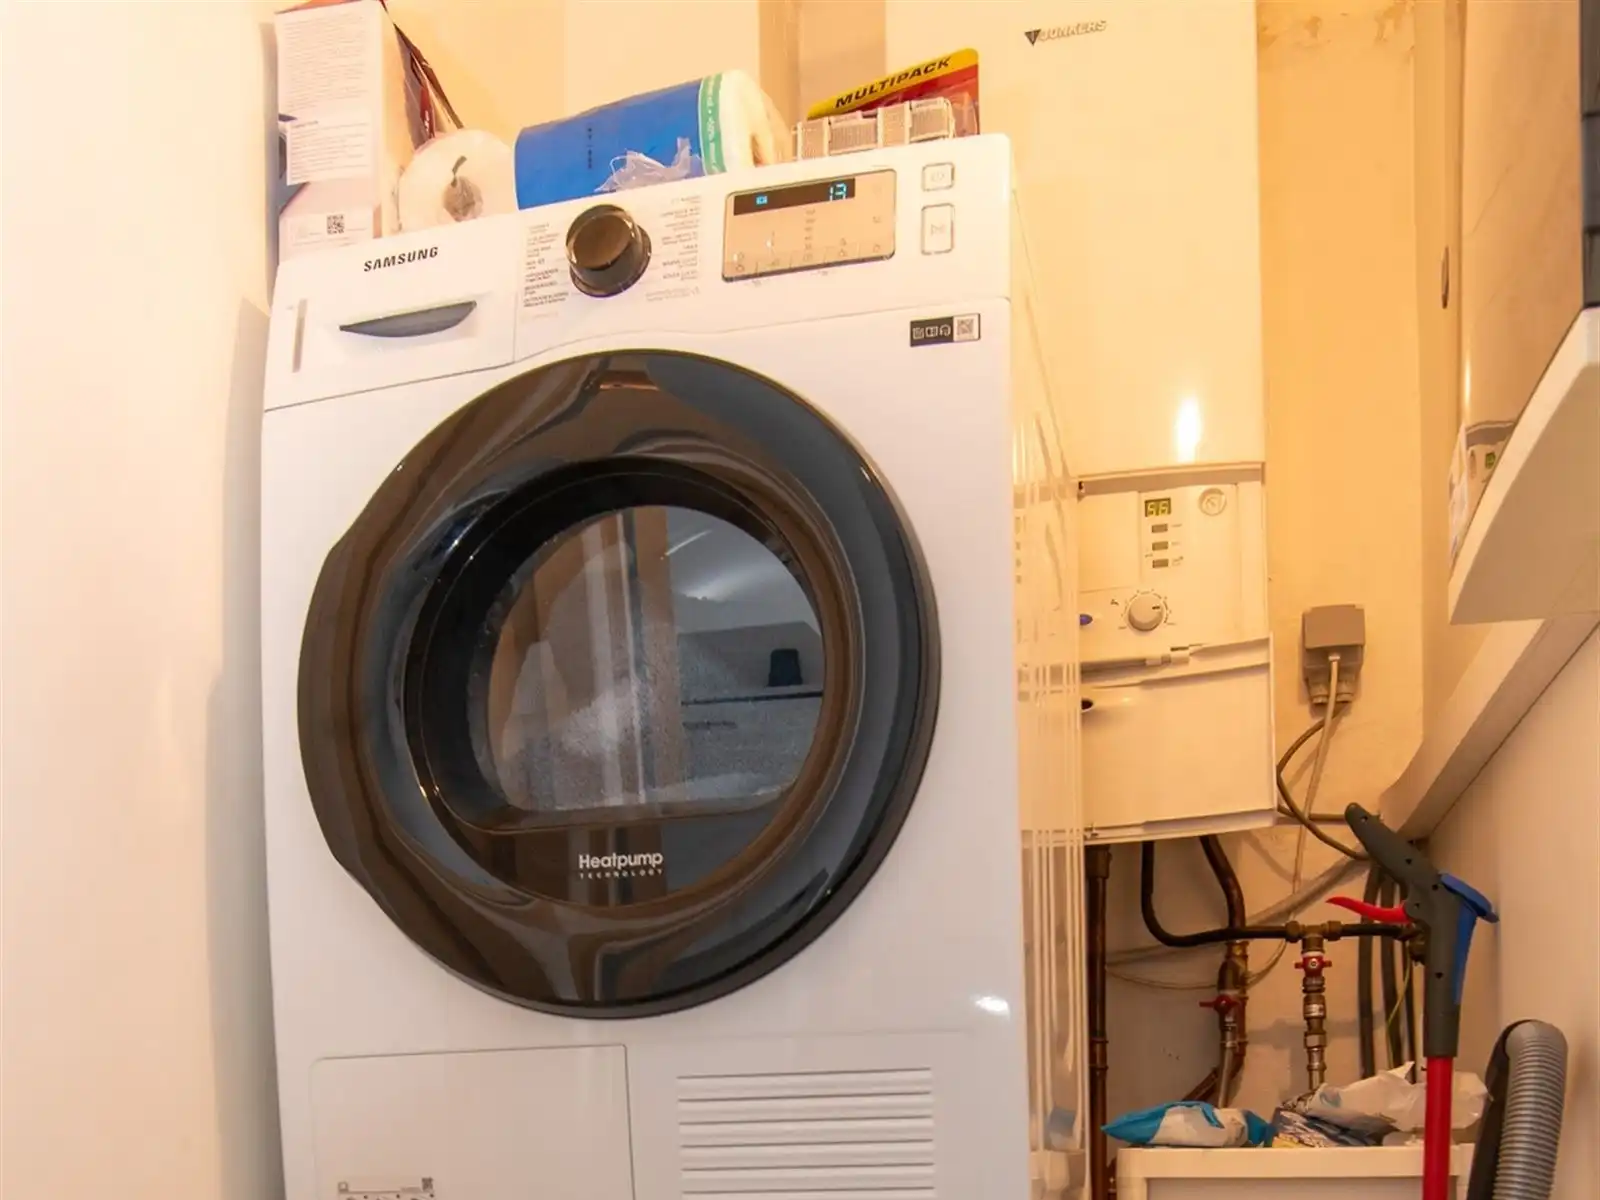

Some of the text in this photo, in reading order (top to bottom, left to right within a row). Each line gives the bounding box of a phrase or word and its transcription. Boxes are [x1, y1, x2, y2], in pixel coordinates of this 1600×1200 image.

[835, 57, 951, 109] MULTIPACK
[363, 246, 439, 272] SAMSUNG
[578, 852, 664, 870] Heatpump
